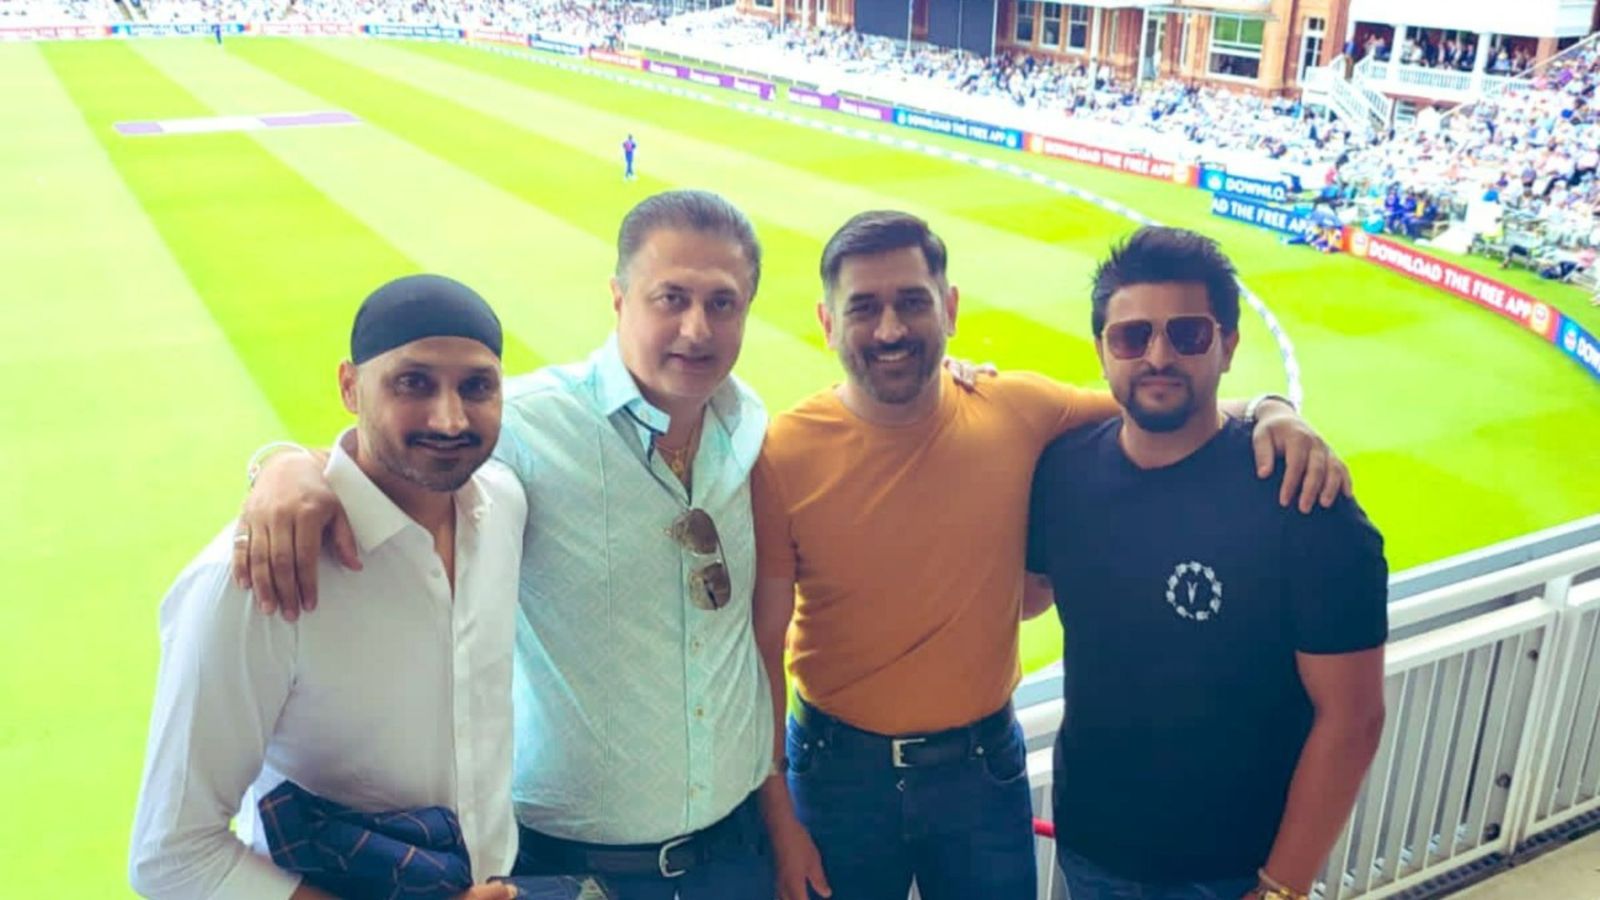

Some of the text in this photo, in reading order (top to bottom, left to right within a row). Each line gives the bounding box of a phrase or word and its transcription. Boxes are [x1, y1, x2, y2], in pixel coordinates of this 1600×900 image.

[1044, 141, 1174, 181] DOWNLOAD THE FREE APP
[1231, 200, 1255, 220] THE
[1256, 207, 1287, 230] FREE
[1369, 241, 1533, 319] DOWNLOAD THE FREE APP
[1576, 336, 1600, 374] DOW
